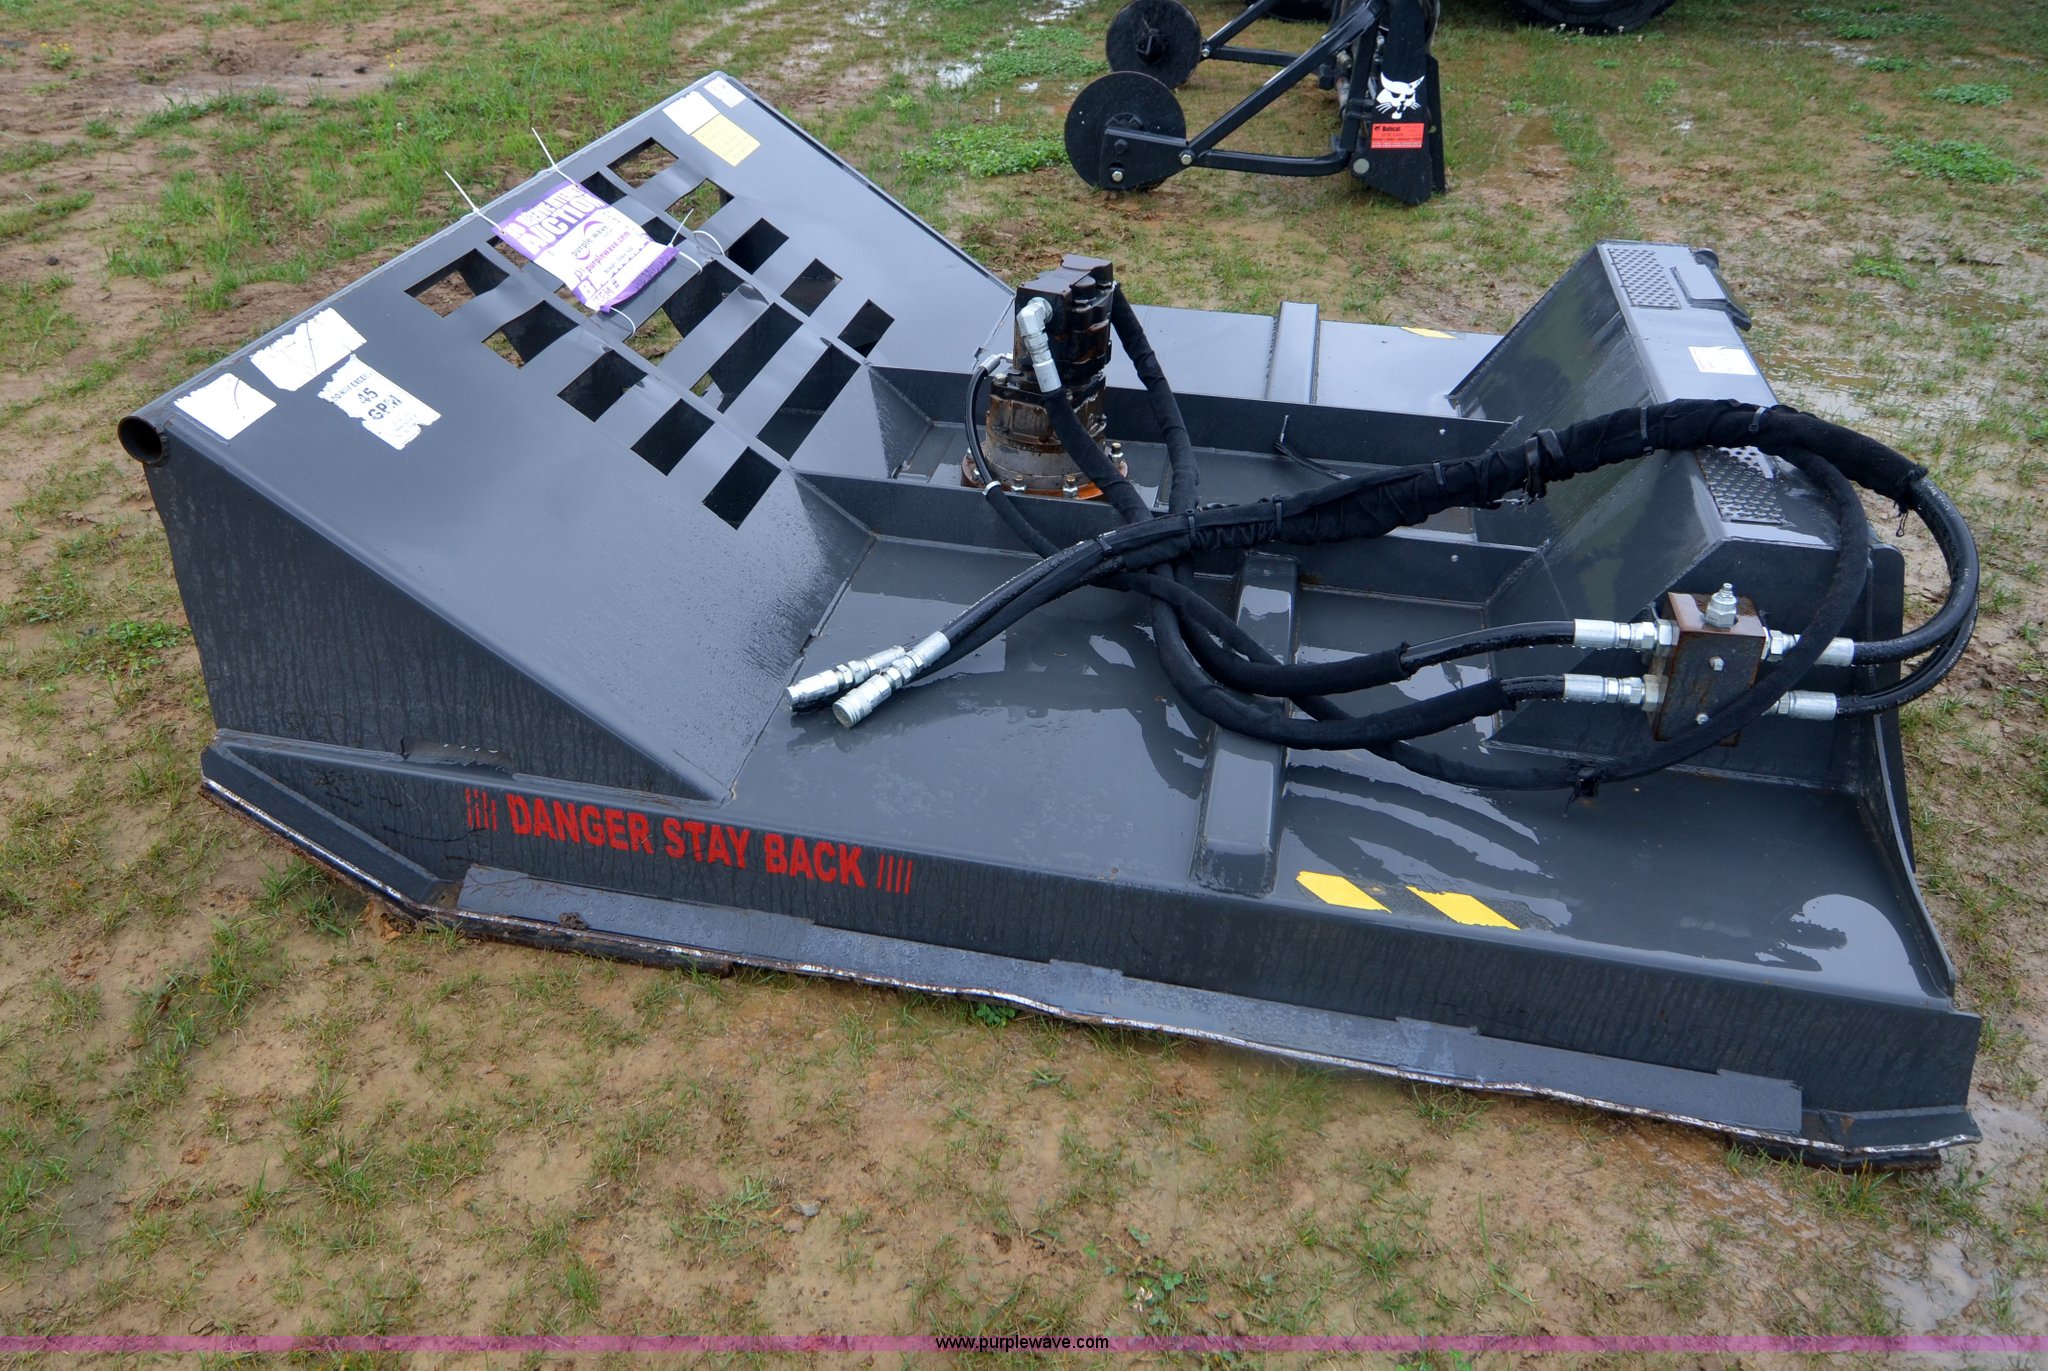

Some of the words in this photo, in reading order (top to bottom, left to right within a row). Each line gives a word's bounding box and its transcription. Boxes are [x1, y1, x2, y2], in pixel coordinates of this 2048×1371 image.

[517, 193, 606, 256] AUCTION
[571, 238, 593, 258] purple
[592, 224, 609, 240] wave
[585, 230, 632, 273] purplewave.com
[357, 387, 378, 404] 45
[367, 393, 403, 420] GPM
[506, 793, 654, 855] DANGER
[663, 816, 752, 869] STAY
[764, 832, 867, 889] BACK
